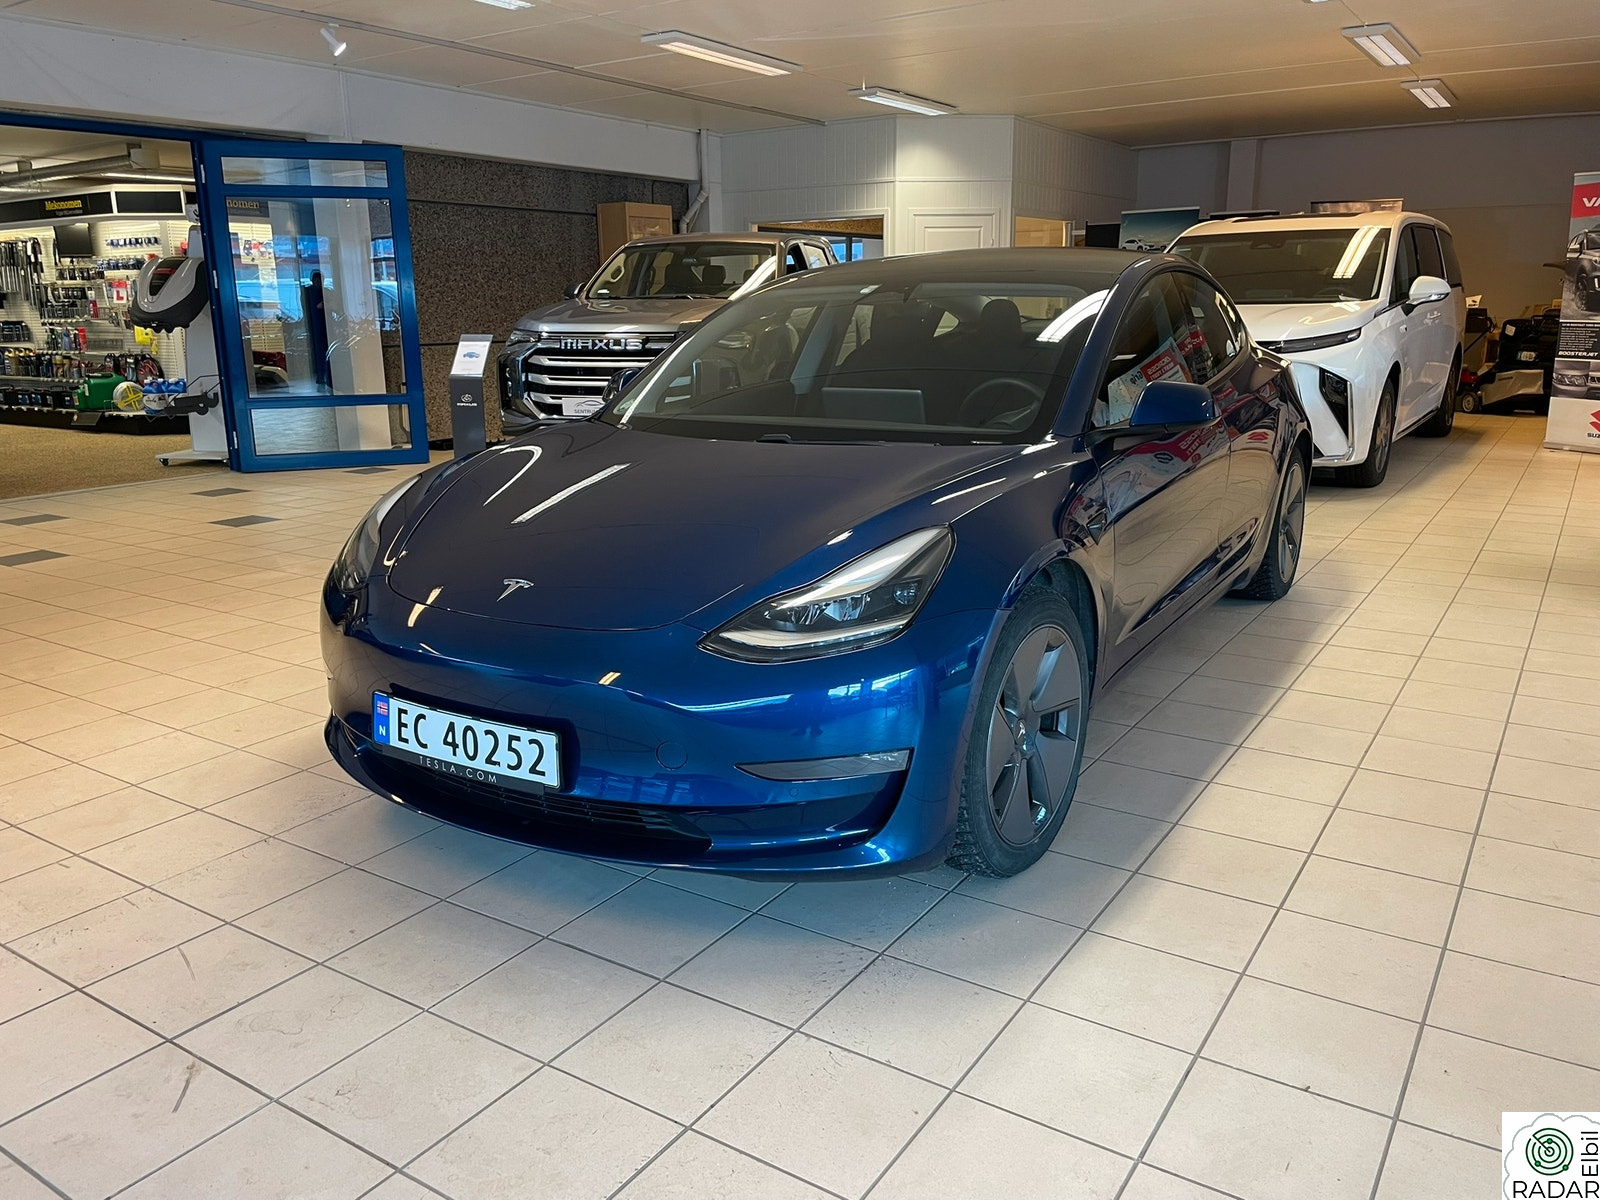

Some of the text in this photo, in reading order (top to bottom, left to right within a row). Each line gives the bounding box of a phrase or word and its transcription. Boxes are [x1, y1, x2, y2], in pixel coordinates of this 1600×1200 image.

[45, 200, 82, 210] Mekonomen
[560, 337, 643, 350] MAXUS
[378, 724, 386, 737] N
[397, 707, 546, 777] EC 40252
[419, 755, 497, 784] TESLA.COM
